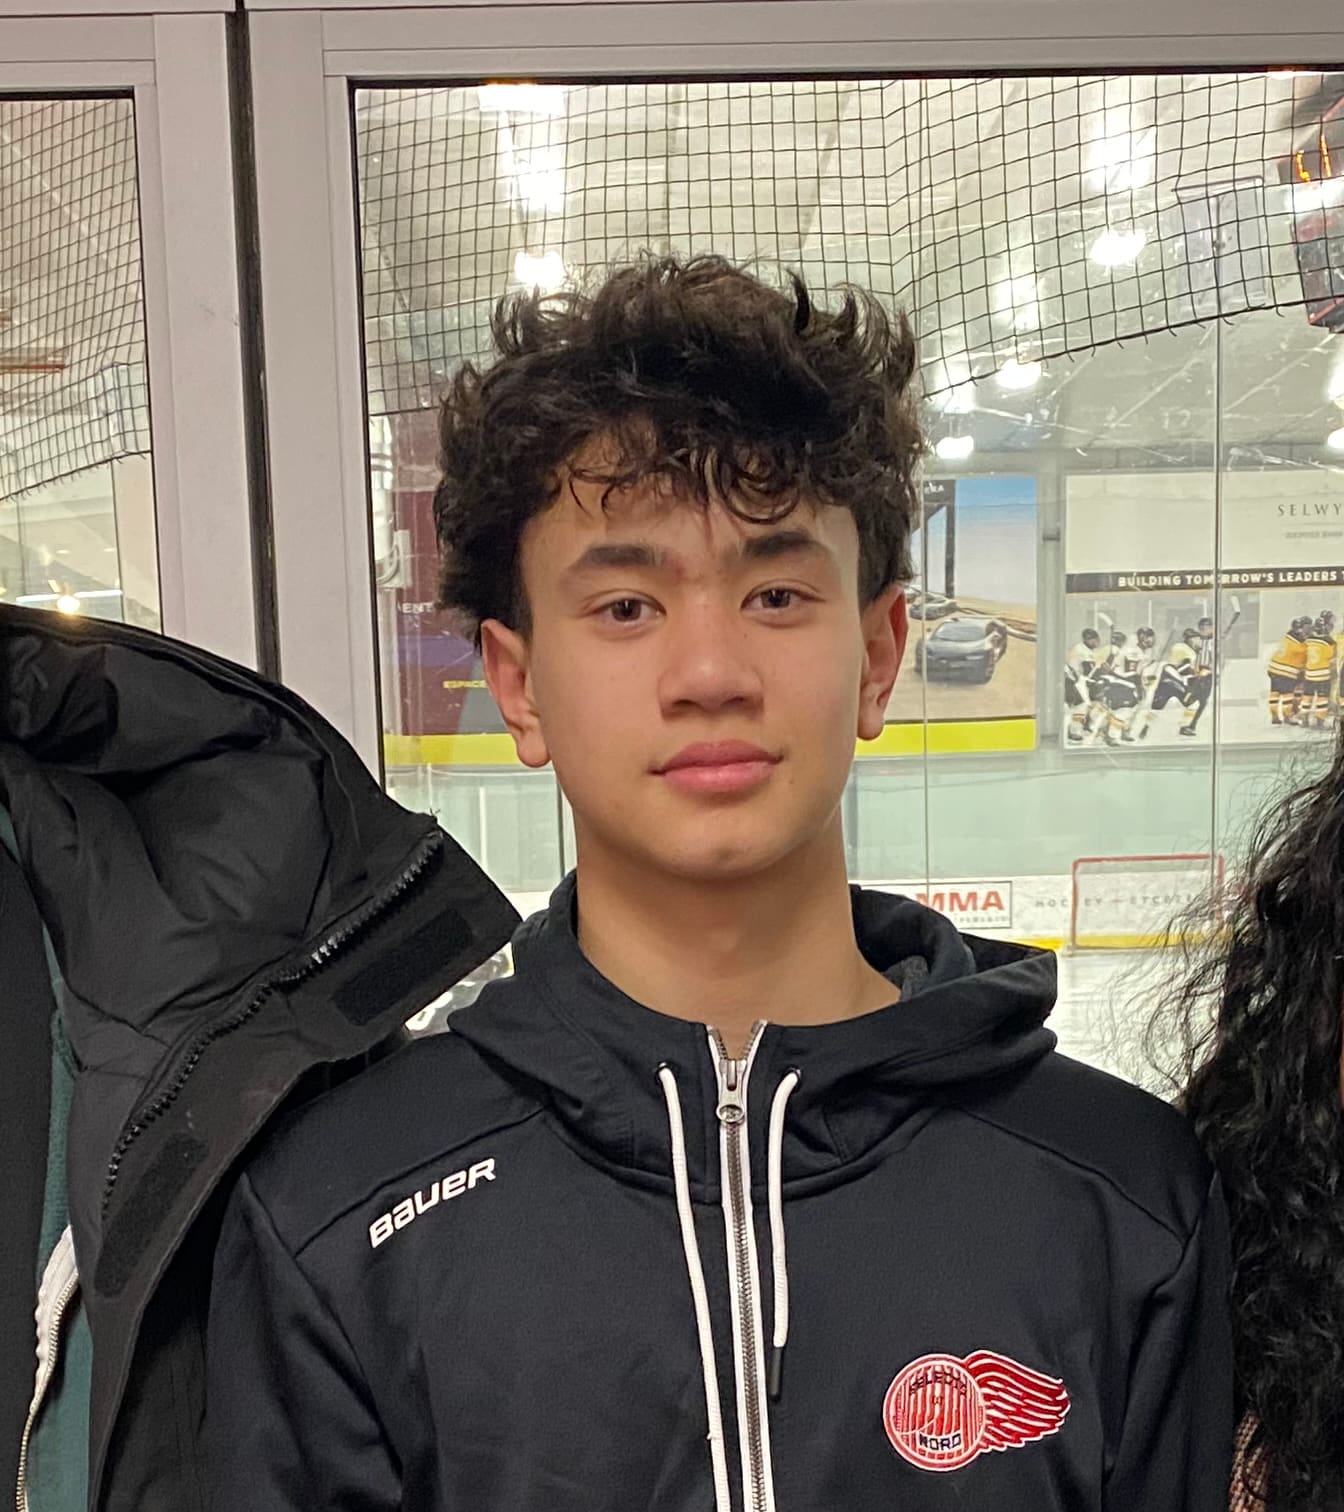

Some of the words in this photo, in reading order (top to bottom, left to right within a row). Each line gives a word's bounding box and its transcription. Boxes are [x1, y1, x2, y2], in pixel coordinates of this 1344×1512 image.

[1118, 573, 1182, 587] BUILDING
[1186, 572, 1275, 586] TOMRROW'S
[1278, 570, 1337, 583] LEADERS
[1034, 897, 1103, 909] HOCEY
[919, 1433, 962, 1450] NORD
